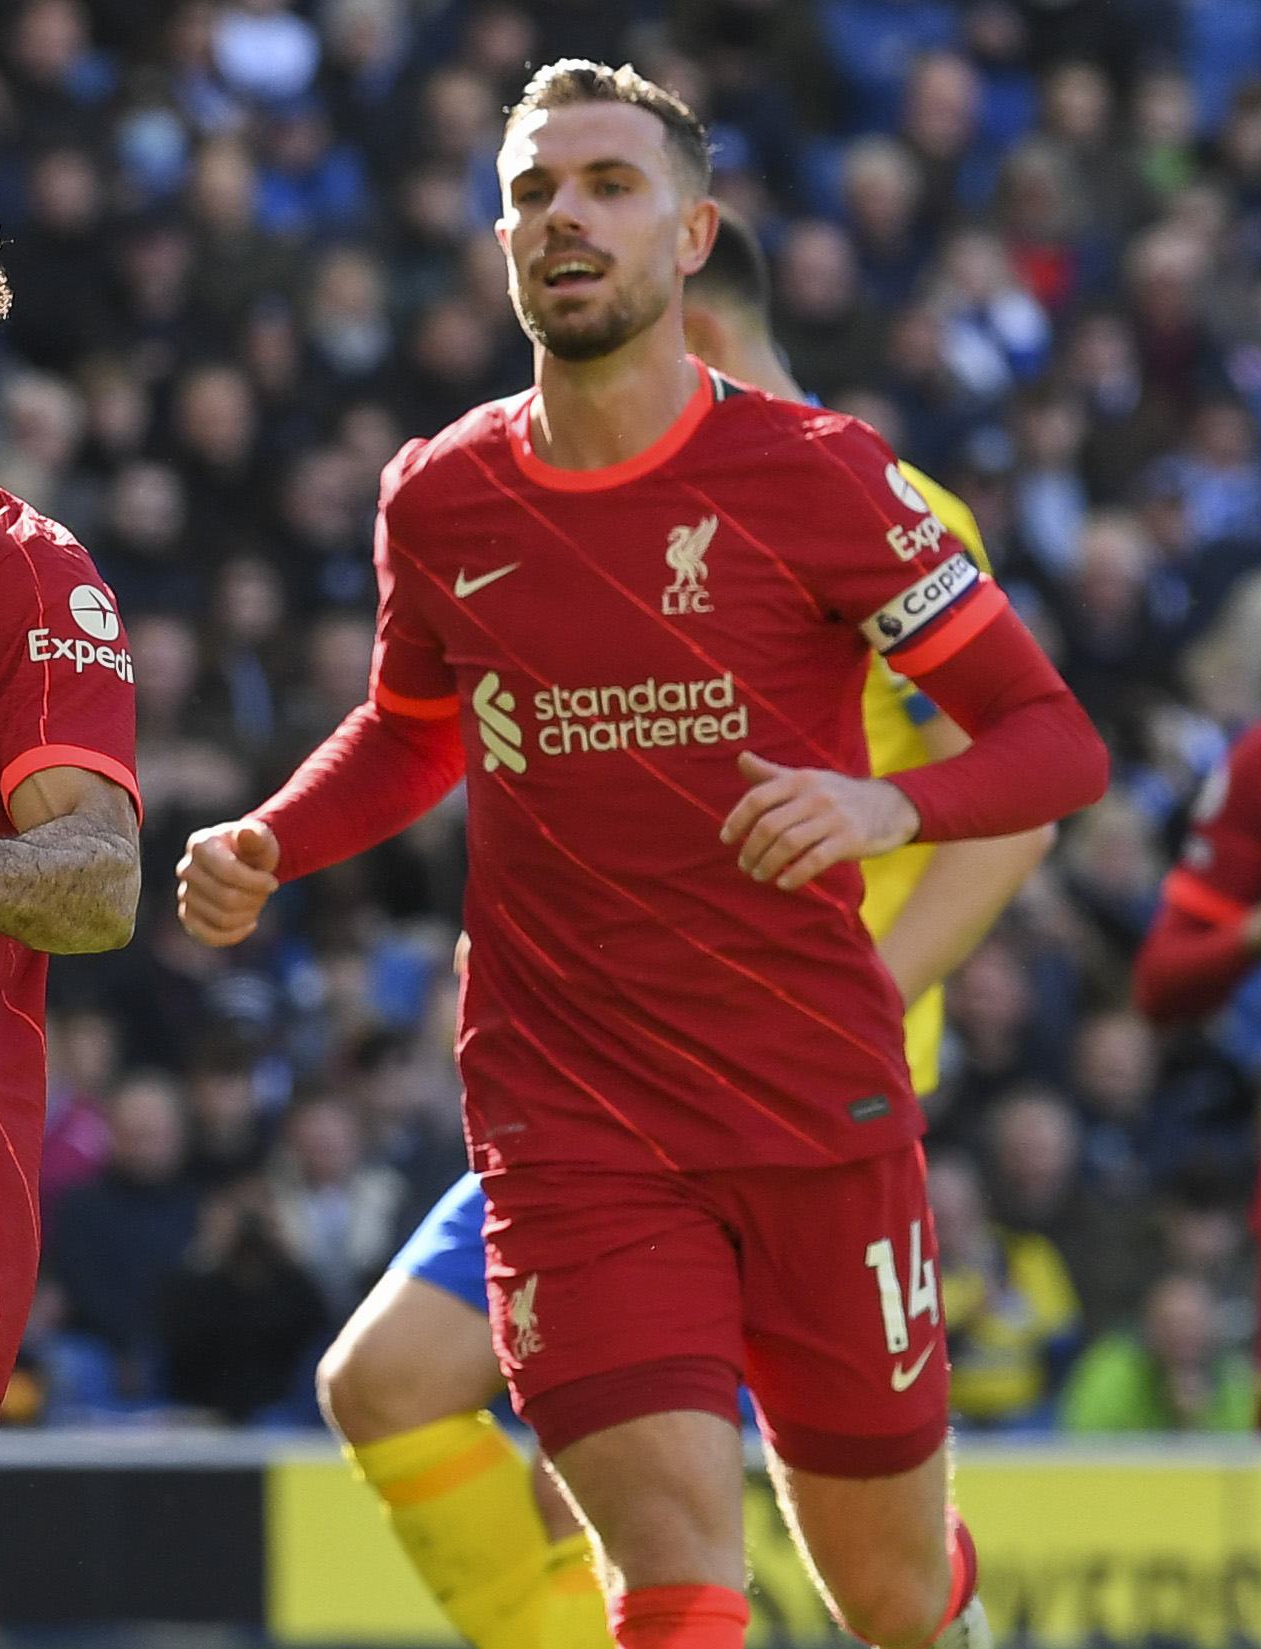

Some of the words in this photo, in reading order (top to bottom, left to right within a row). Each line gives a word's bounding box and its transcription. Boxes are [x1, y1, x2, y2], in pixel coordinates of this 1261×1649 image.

[886, 513, 948, 562] Exp
[28, 628, 134, 684] Expedi
[534, 670, 733, 721] standard
[539, 704, 748, 755] chartered
[865, 1219, 940, 1354] 14
